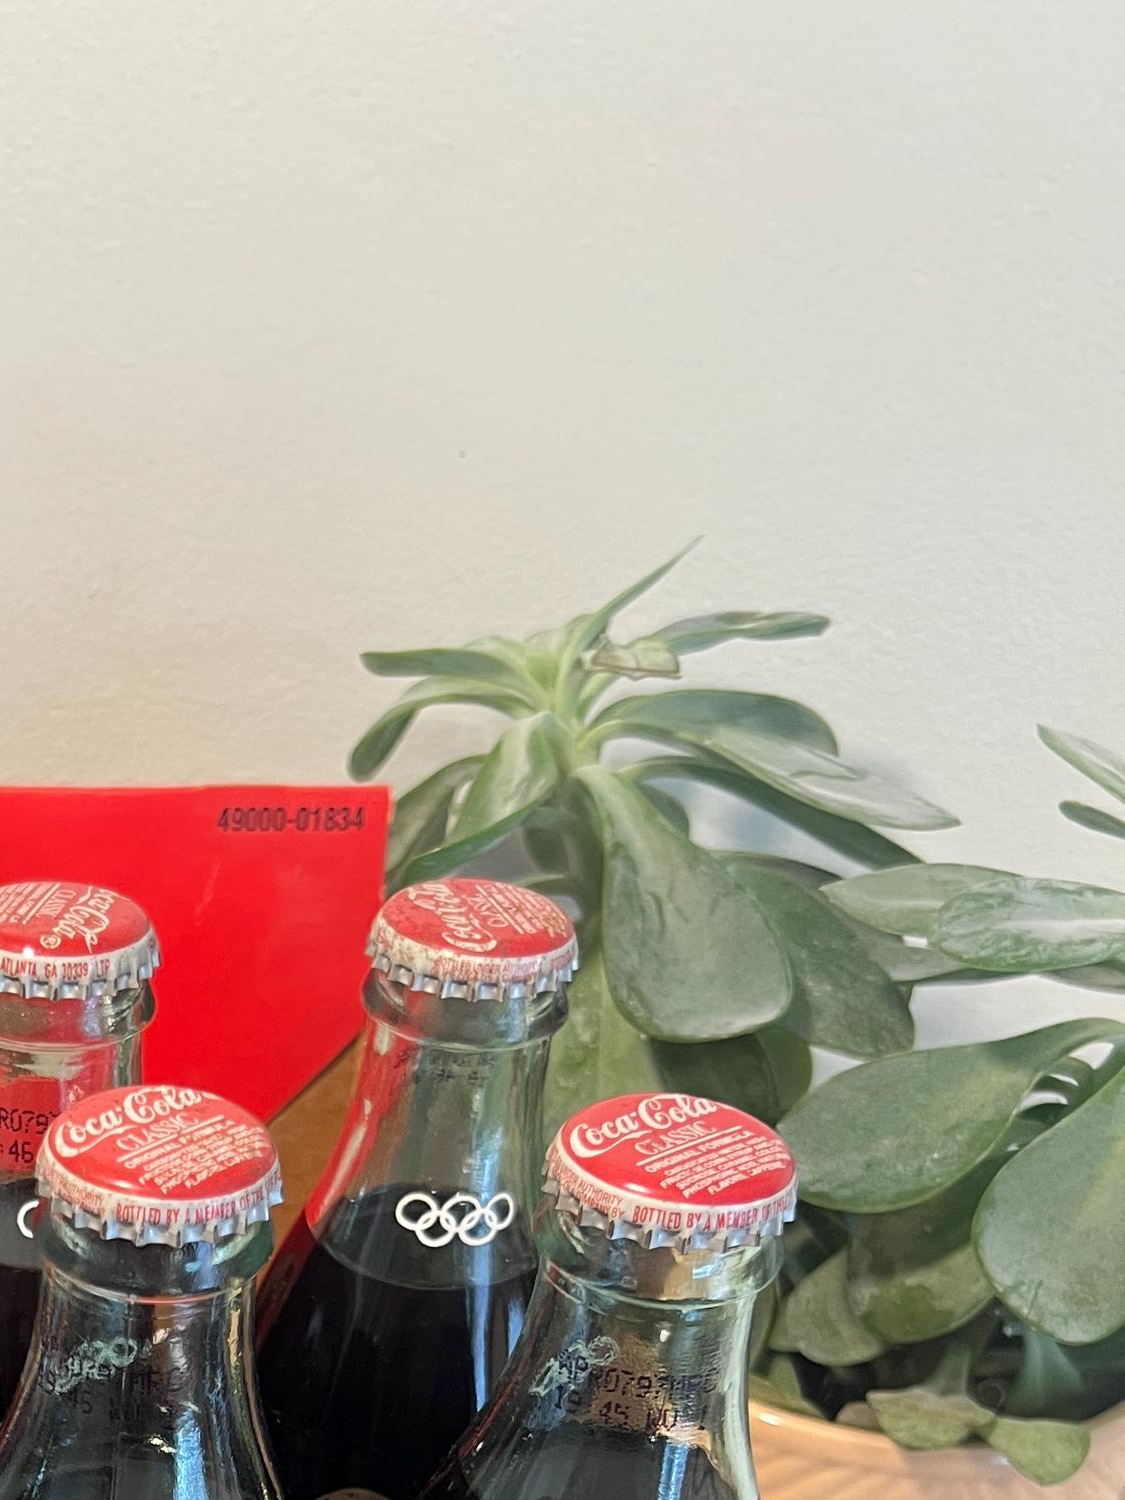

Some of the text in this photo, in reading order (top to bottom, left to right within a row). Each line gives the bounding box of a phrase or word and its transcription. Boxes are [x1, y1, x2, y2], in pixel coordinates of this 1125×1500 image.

[217, 806, 366, 832] 49000-01834
[44, 963, 57, 978] GA
[62, 964, 89, 981] 30339
[55, 1085, 202, 1158] Coca-Cola
[116, 1112, 200, 1152] CLASSIC
[569, 1094, 718, 1158] Coca-Cola
[634, 1120, 717, 1156] CLASSIC
[644, 1149, 703, 1173] ORIGINAL
[698, 1130, 756, 1152] FORMULA
[116, 1203, 161, 1226] BOTTLED
[166, 1207, 180, 1226] BY
[185, 1207, 191, 1224] A
[195, 1200, 236, 1225] MEMBER
[240, 1192, 250, 1211] OF
[577, 1180, 624, 1207] AUTHORITY
[632, 1205, 682, 1230] BOTTLED
[686, 1211, 702, 1229] BY
[703, 1213, 711, 1231] A
[716, 1207, 758, 1230] MEMBER
[762, 1203, 771, 1221] OF
